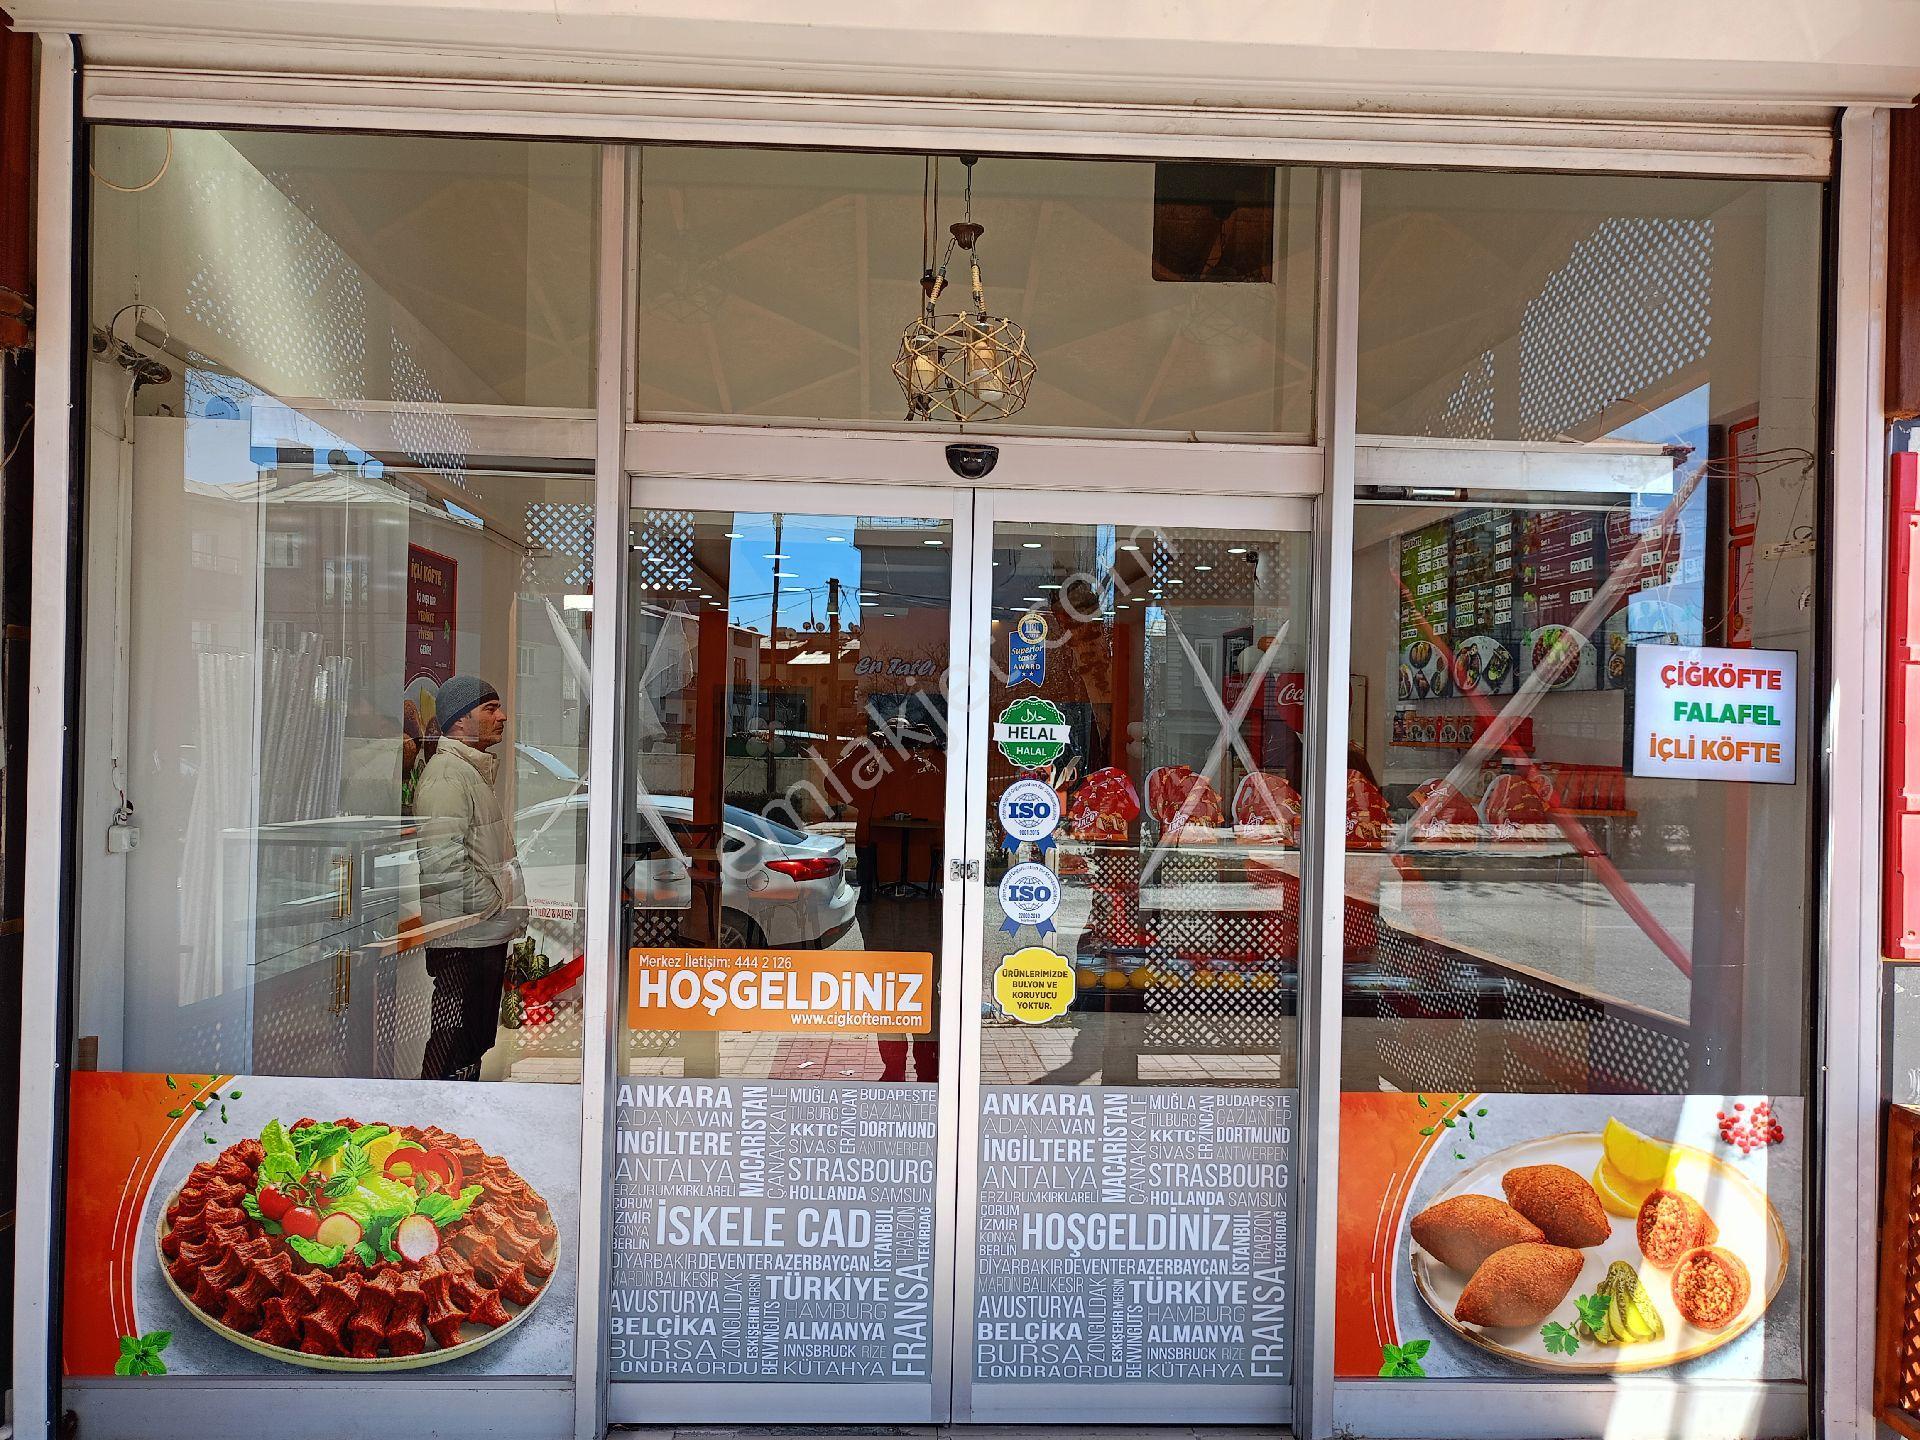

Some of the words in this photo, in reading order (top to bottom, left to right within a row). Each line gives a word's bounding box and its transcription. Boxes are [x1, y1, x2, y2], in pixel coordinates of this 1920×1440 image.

[1571, 561, 1582, 573] 220
[1583, 560, 1592, 569] TL
[1571, 592, 1582, 602] 270
[1583, 590, 1592, 600] TL
[1011, 645, 1043, 655] Superior
[1018, 654, 1037, 662] taste
[1661, 661, 1782, 690] ÇİĞKÖFTE
[1021, 709, 1046, 722] حلال
[1674, 701, 1781, 726] FALAFEL
[1008, 726, 1057, 740] HELAL
[1016, 746, 1047, 756] HALAL
[1649, 733, 1695, 762] İÇLİ
[1701, 736, 1781, 764] KÖFTE
[1009, 803, 1050, 818] ISO
[1009, 885, 1051, 901] ISO
[639, 954, 682, 968] Merkez
[685, 954, 731, 970] İletişim:
[734, 956, 758, 968] 444
[762, 956, 768, 968] 2
[773, 956, 792, 969] 126
[1002, 969, 1068, 978] ÜRÜNLERİMİZDE
[1017, 1002, 1052, 1010] YOKTUR.
[790, 1013, 922, 1027] www.cigkoftem.com
[617, 1084, 733, 1108] ANKARA
[790, 1086, 838, 1104] MUĞLA
[860, 1088, 936, 1104] BUDAPEŞTE
[1150, 1093, 1196, 1110] MUĞLA
[1217, 1095, 1290, 1109] BUDAPEŞTE
[860, 1101, 937, 1120] GAZİANTEP
[983, 1093, 1094, 1116] ANKARA
[617, 1110, 695, 1126] ADANA
[697, 1111, 732, 1127] VAN
[838, 1088, 857, 1154] ERZİNCAN
[1216, 1107, 1291, 1126] GAZİANTEP
[859, 1121, 936, 1139] DORTMUND
[983, 1118, 1059, 1134] ADANA
[1060, 1119, 1095, 1134] VAN
[1195, 1095, 1214, 1160] ERZİNCAN
[1217, 1127, 1290, 1143] DORTMUND
[617, 1127, 732, 1156] İNGİLTERE
[736, 1086, 767, 1197] MACARİSTAN
[768, 1088, 787, 1199] ÇANAKKALE
[789, 1138, 836, 1154] SİVAS
[859, 1141, 933, 1156] ANTWERPEN
[984, 1135, 1095, 1163] İNGİLTERE
[1098, 1094, 1128, 1203] MACARİSTAN
[1129, 1095, 1148, 1205] ÇANAKKALE
[1150, 1143, 1195, 1160] SİVAS
[1216, 1146, 1288, 1161] ANTWERPEN
[615, 1158, 734, 1183] ANTALYA
[788, 1157, 933, 1184] STRASBOURG
[982, 1166, 1097, 1189] ANTALYA
[1149, 1163, 1288, 1188] STRASBOURG
[615, 1184, 675, 1196] ERZURUM
[676, 1184, 736, 1196] KIRKLARELİ
[790, 1185, 866, 1200] HOLLANDA
[871, 1187, 932, 1202] SAMSUN
[981, 1191, 1039, 1202] ERZURUM
[1041, 1190, 1098, 1203] KIRKLARELİ
[1151, 1191, 1224, 1206] HOLLANDA
[1228, 1192, 1287, 1208] SAMSUN
[614, 1211, 651, 1224] ZMİR
[980, 1205, 1020, 1217] ÇORUM
[613, 1225, 648, 1236] KONYA
[657, 1199, 785, 1246] İSKELE
[798, 1208, 871, 1248] CAD
[980, 1217, 1017, 1230] İZMİR
[1023, 1206, 1231, 1258] HOŞGELDİNİZ
[870, 1206, 893, 1272] İSTANBUL
[896, 1206, 915, 1263] TRABZON
[917, 1206, 932, 1261] TEKİRDAĞ
[979, 1232, 1016, 1242] KONYA
[1230, 1210, 1250, 1275] İSTANBUL
[1253, 1210, 1271, 1266] TRABZON
[1273, 1211, 1287, 1264] TEKİRDAĞ
[979, 1243, 1017, 1256] BERLİN
[613, 1250, 696, 1269] DİYARBAKIR
[700, 1252, 773, 1270] DEVENTER
[775, 1254, 870, 1272] AZERBAYCAN
[979, 1257, 1063, 1275] DİYARBAKIR
[1065, 1258, 1135, 1275] DEVENTER
[1137, 1259, 1229, 1275] AZERBAYCAN
[656, 1269, 719, 1287] BALIKESİR
[766, 1272, 889, 1301] TÜRKİYE
[1023, 1276, 1084, 1293] BALIKESİR
[1129, 1276, 1248, 1304] TÜRKİYE
[612, 1290, 720, 1313] AVUSTURYA
[978, 1296, 1085, 1318] AVUSTURYA
[722, 1273, 742, 1358] ZONGULDAK
[784, 1302, 887, 1320] HAMBURG
[892, 1263, 928, 1376] FRANSA
[1087, 1277, 1107, 1362] ZONGULDAK
[1147, 1306, 1245, 1322] HAMBURG
[612, 1315, 716, 1338] BELÇİKA
[1251, 1266, 1286, 1377] FRANSA
[762, 1301, 780, 1374] BENVINGUTS
[784, 1322, 885, 1341] ALMANYA
[978, 1320, 1083, 1343] BELÇİKA
[1148, 1325, 1244, 1343] ALMANYA
[611, 1339, 717, 1360] BURSA
[1126, 1305, 1143, 1378] BENVINGUTS
[783, 1344, 856, 1358] INNSBRUCK
[978, 1344, 1083, 1364] BURSA
[1147, 1348, 1217, 1360] INNSBRUCK
[697, 1362, 758, 1375] ORDU
[783, 1359, 885, 1376] KÜTAHYA
[978, 1365, 1061, 1378] LONDRA
[1064, 1365, 1122, 1378] ORDU
[1147, 1362, 1244, 1378] KÜTAHYA
